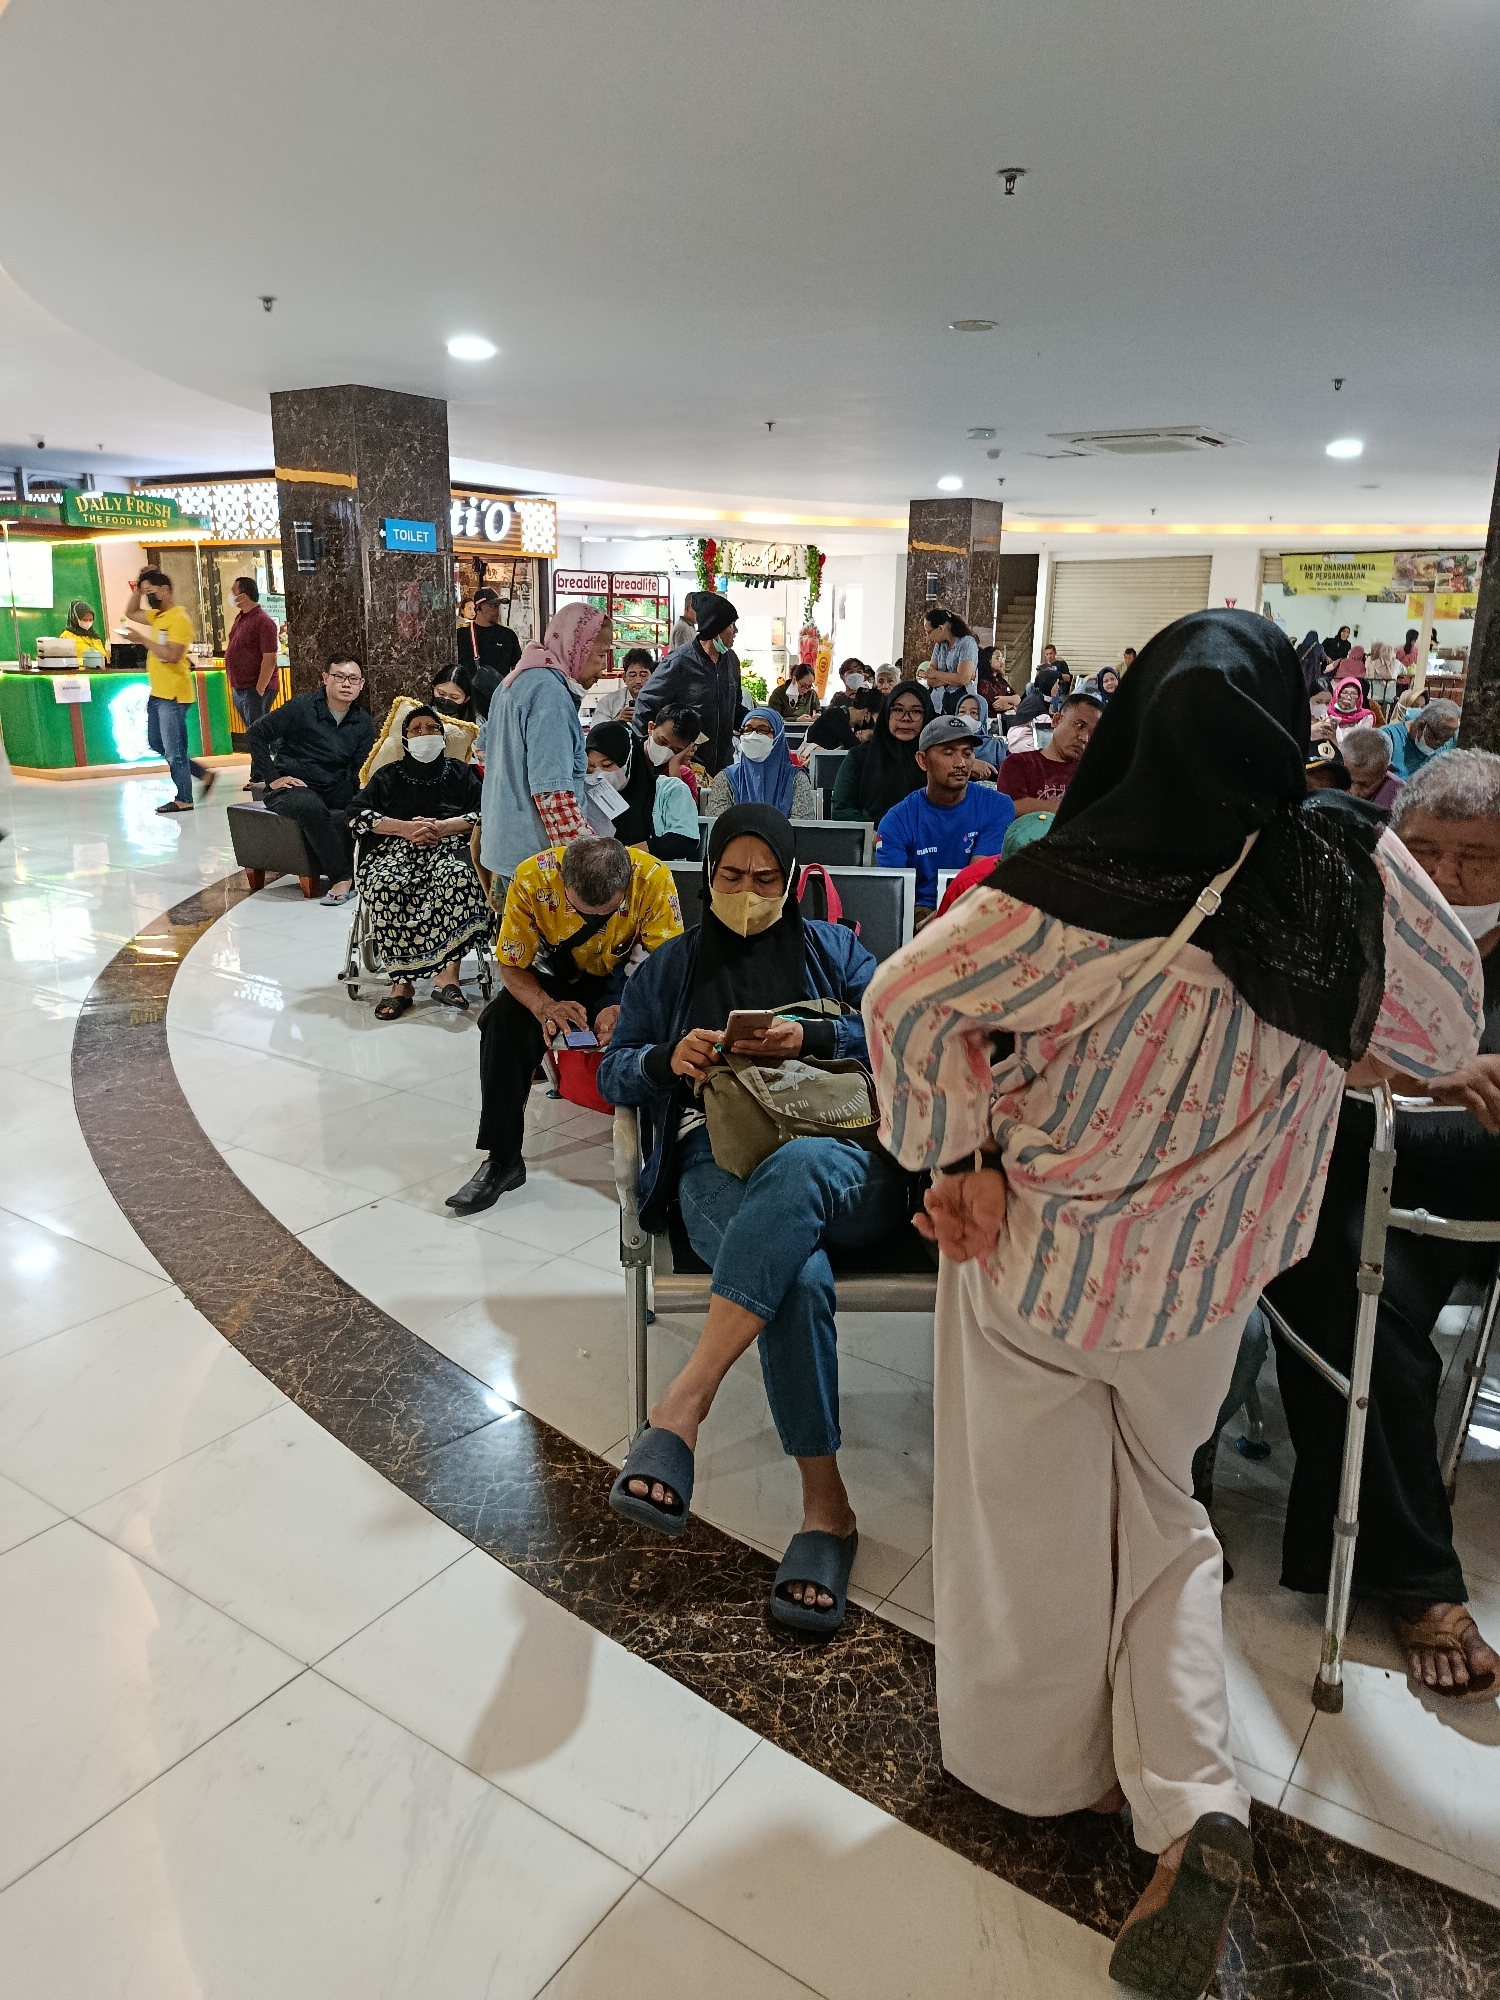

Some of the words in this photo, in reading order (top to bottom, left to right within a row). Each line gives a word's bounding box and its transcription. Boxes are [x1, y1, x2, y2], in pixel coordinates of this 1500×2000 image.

[75, 496, 122, 513] DAILY
[126, 496, 171, 519] FRESH
[83, 514, 103, 523] THE
[105, 516, 133, 526] FOOD
[135, 518, 168, 528] HOUSE
[450, 497, 511, 541] ti'O
[392, 528, 429, 543] TOILET
[1299, 563, 1323, 572] KANTIN
[1323, 563, 1376, 572] DHARMAWANITA
[557, 574, 607, 591] breadlife
[1304, 572, 1314, 580] RS
[1315, 572, 1366, 580] PERSAHABATAN
[614, 577, 657, 592] breadlife
